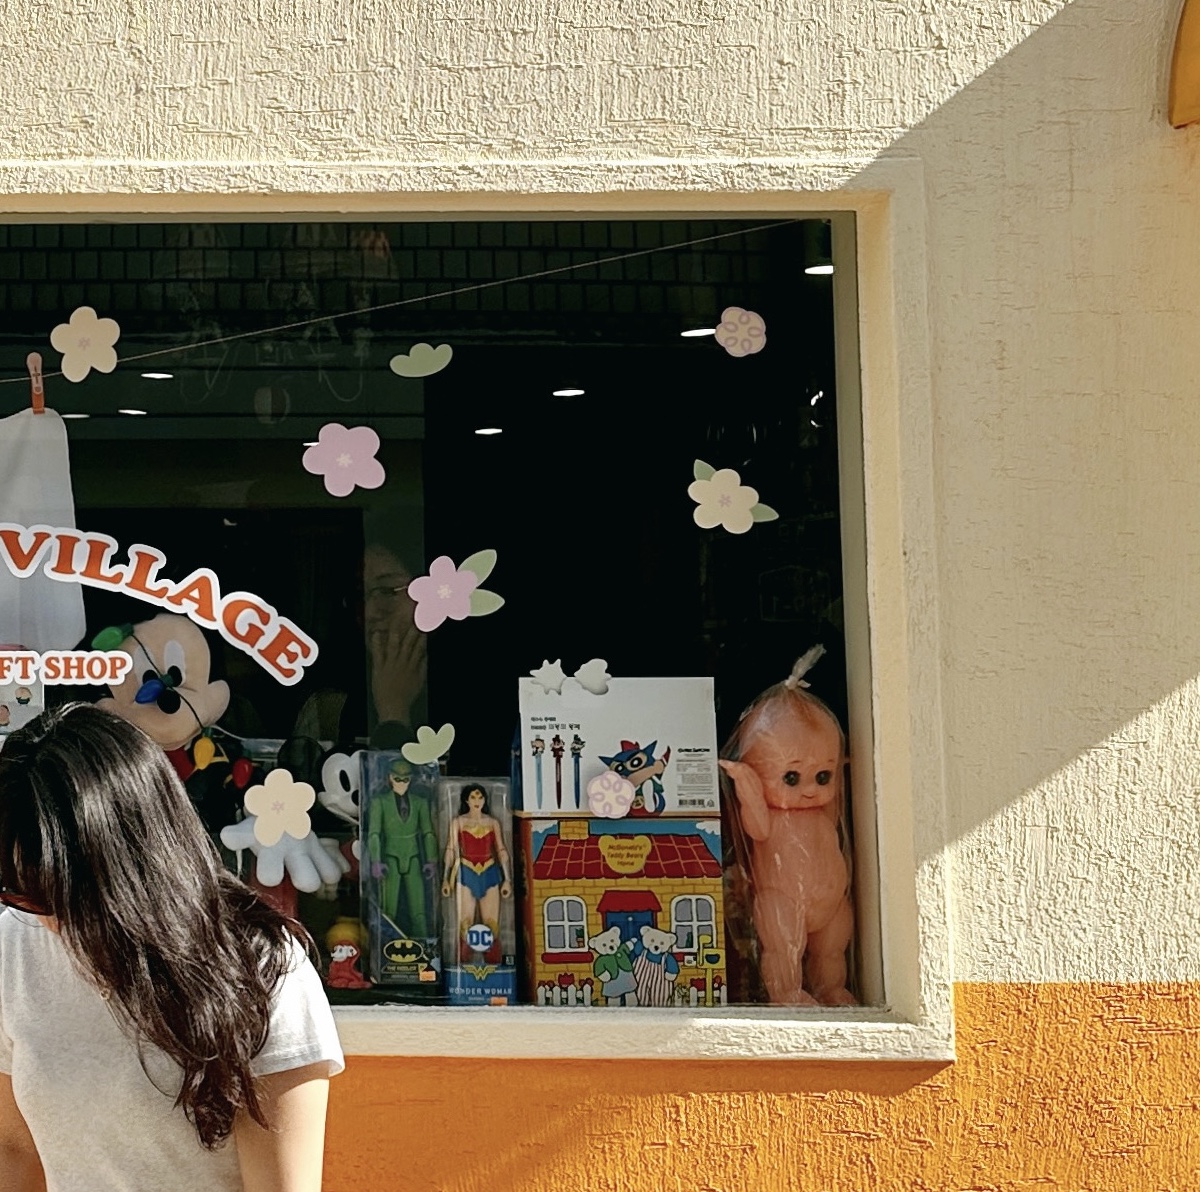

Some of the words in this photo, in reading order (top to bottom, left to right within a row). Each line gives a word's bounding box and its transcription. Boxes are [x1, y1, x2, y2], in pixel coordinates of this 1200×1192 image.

[44, 656, 127, 680] SHOP
[468, 930, 493, 946] DC
[449, 987, 483, 995] WONDER
[484, 987, 512, 995] WOMAN
